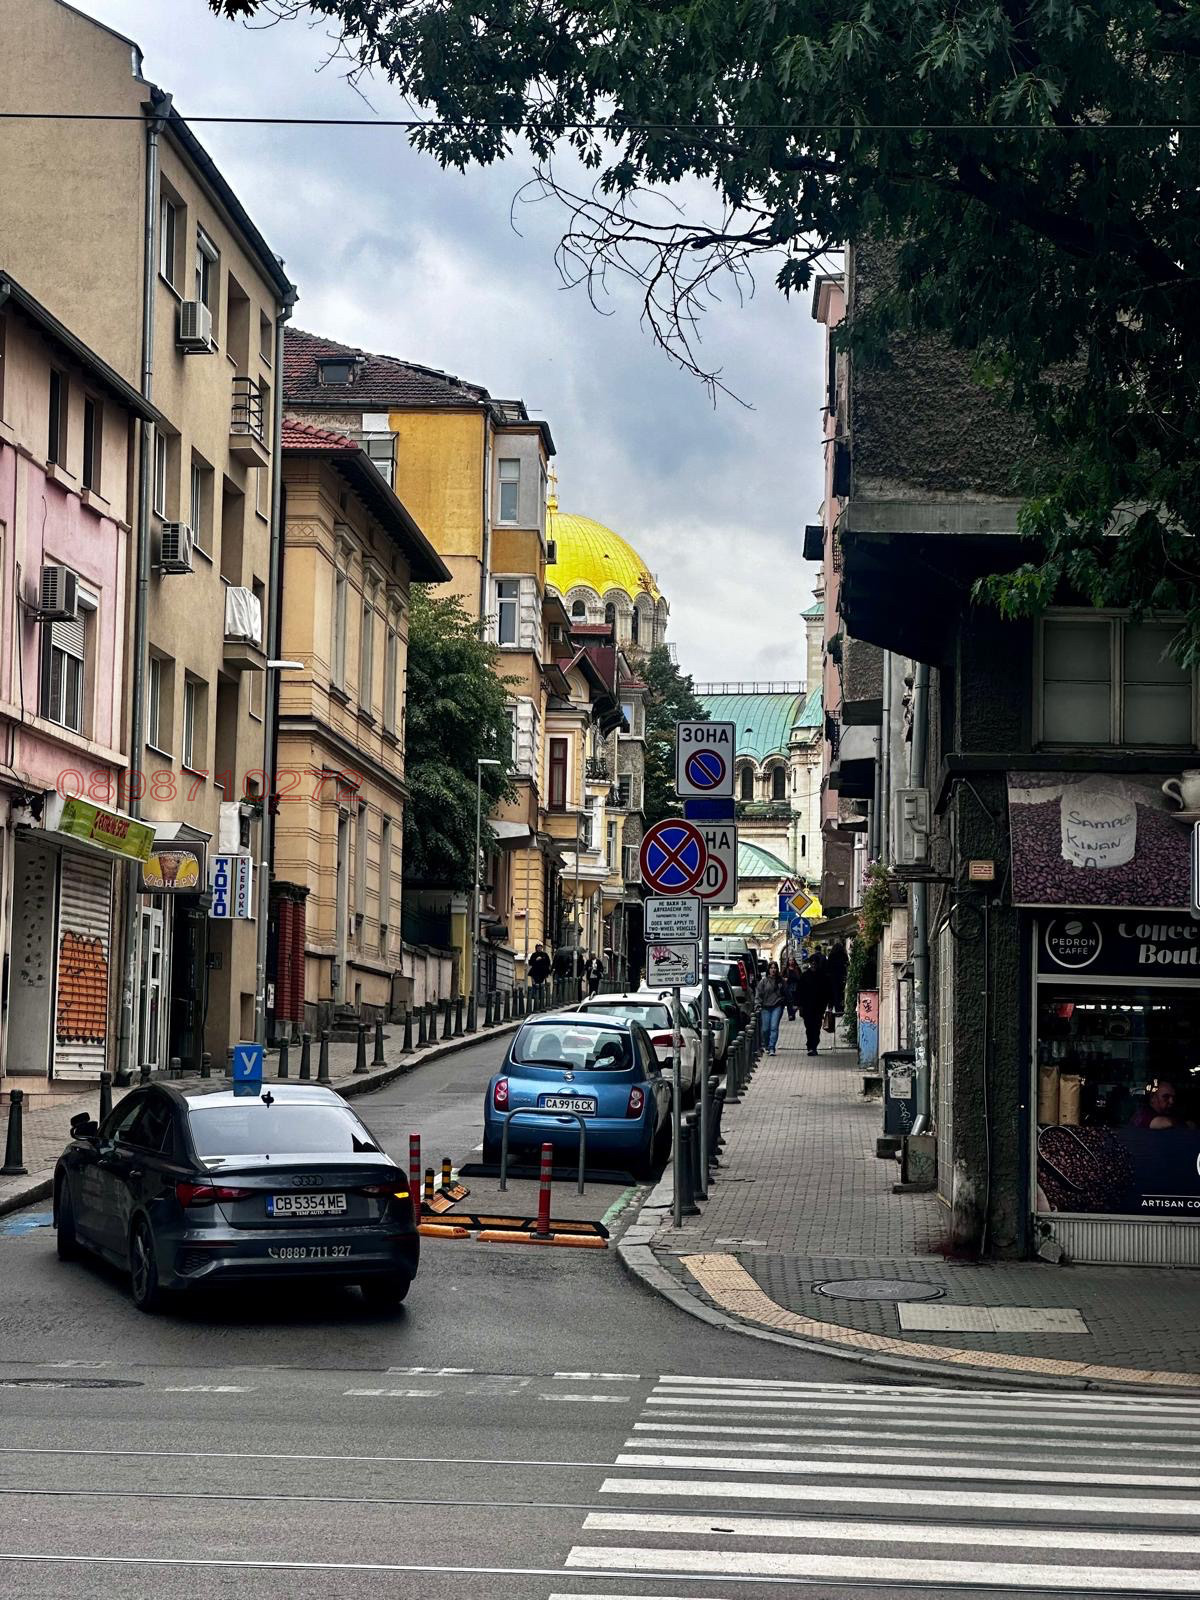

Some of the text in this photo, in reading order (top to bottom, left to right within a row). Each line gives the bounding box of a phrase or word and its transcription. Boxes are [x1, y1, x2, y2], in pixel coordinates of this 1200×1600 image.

[682, 728, 729, 743] ЗОНА
[705, 832, 730, 849] НА
[145, 873, 197, 887] ДЮНЕРИ
[213, 858, 228, 917] ТОТО
[238, 858, 246, 917] КСЕРОКС
[1052, 938, 1096, 946] PEDRON
[1138, 944, 1200, 964] Bout
[546, 1099, 593, 1111] CA 9916 CK
[275, 1195, 345, 1210] CB 5354 ME
[1141, 1200, 1184, 1208] ARTISAN
[280, 1245, 351, 1259] 0889 711 327
